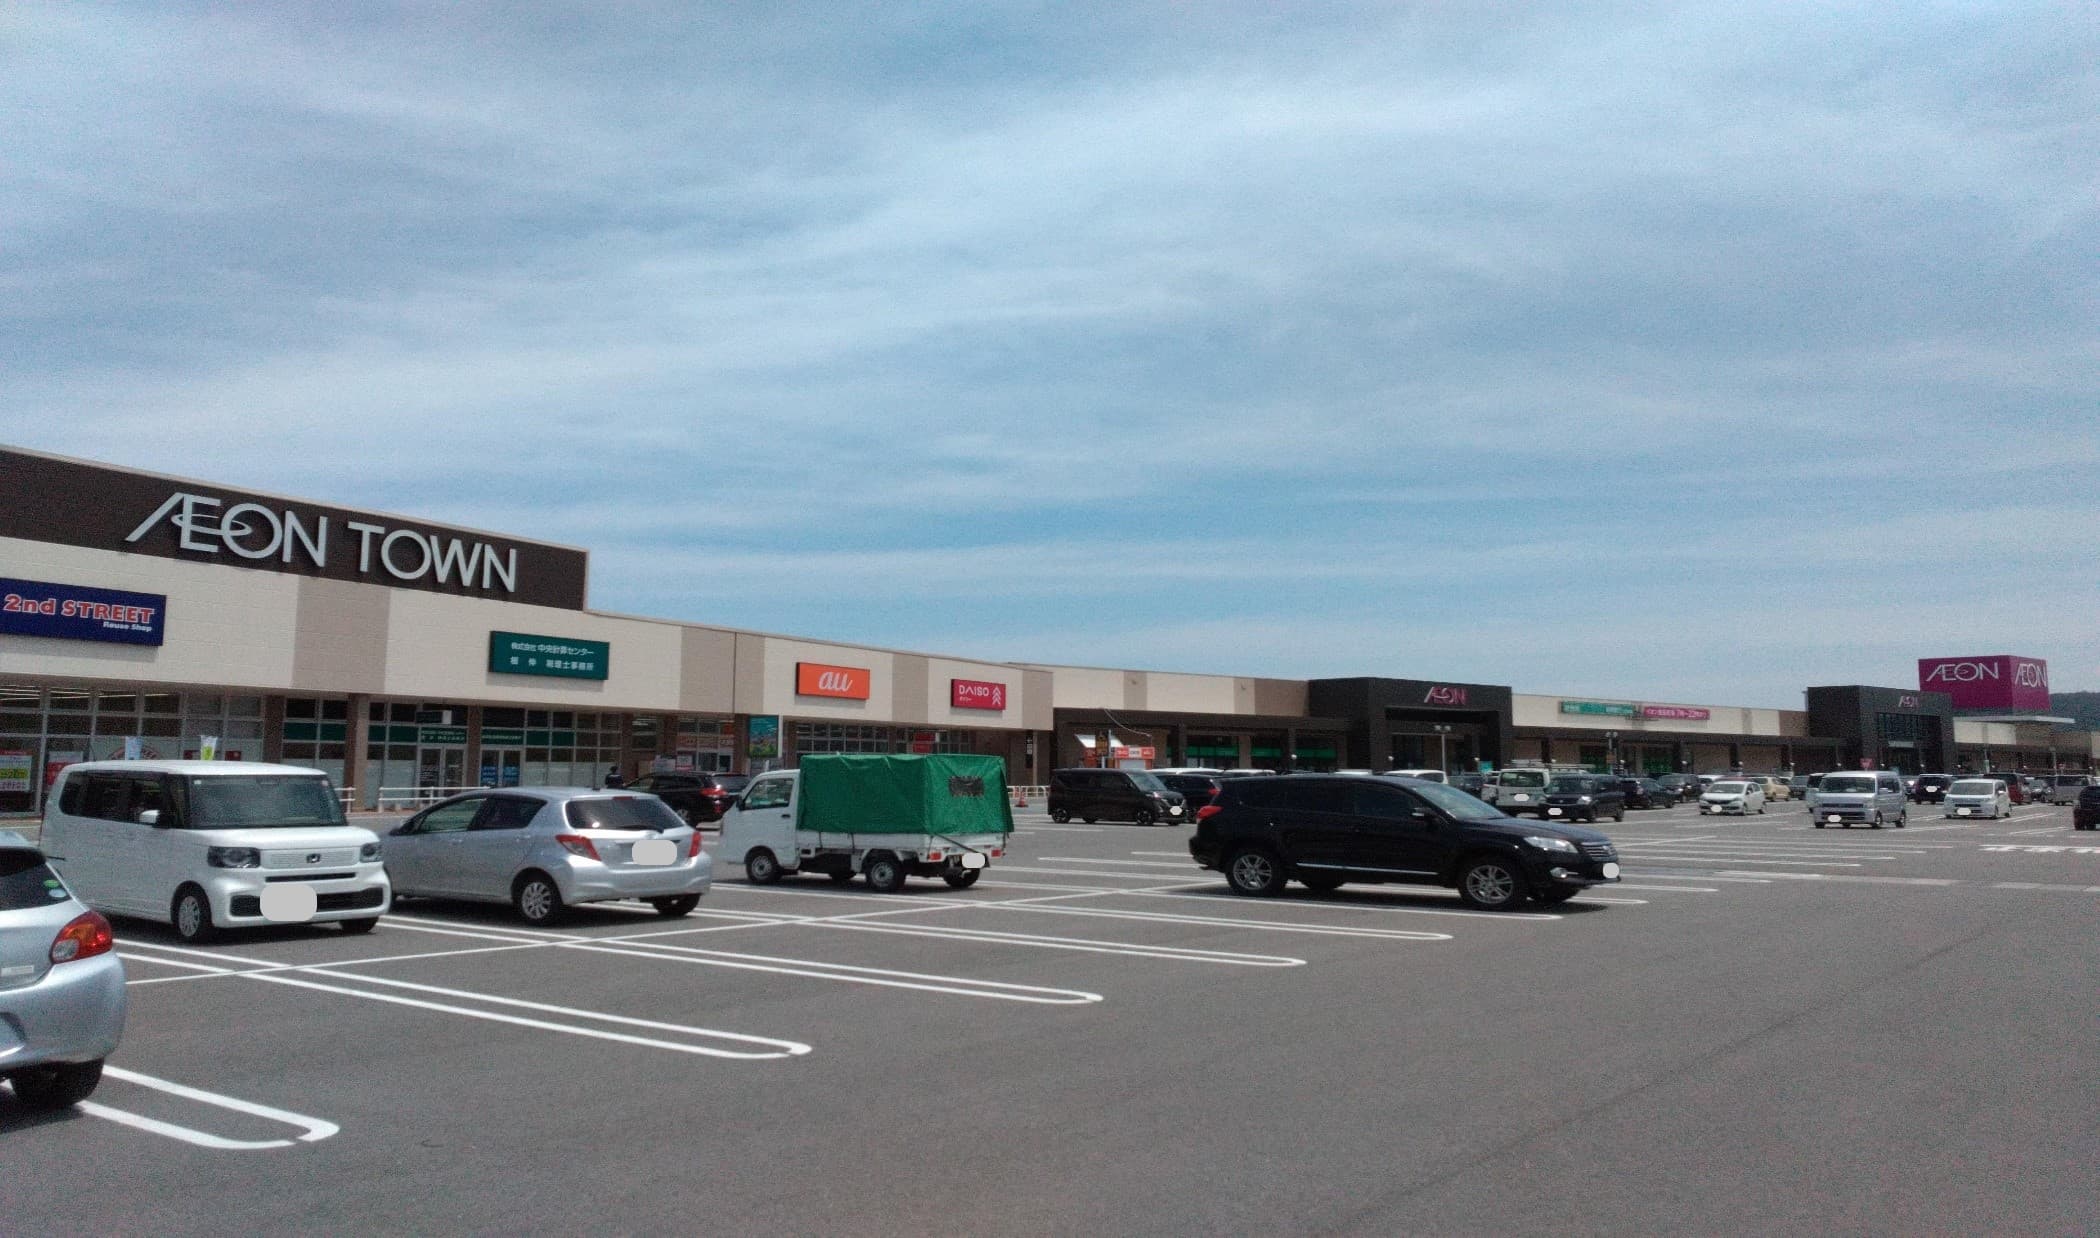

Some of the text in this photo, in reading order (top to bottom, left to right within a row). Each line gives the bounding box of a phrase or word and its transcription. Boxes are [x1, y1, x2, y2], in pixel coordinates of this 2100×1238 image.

[348, 521, 517, 593] TOWN
[3, 594, 155, 624] 2nd STREET
[131, 623, 153, 633] Shop
[818, 671, 853, 692] au
[958, 684, 990, 697] DAISO
